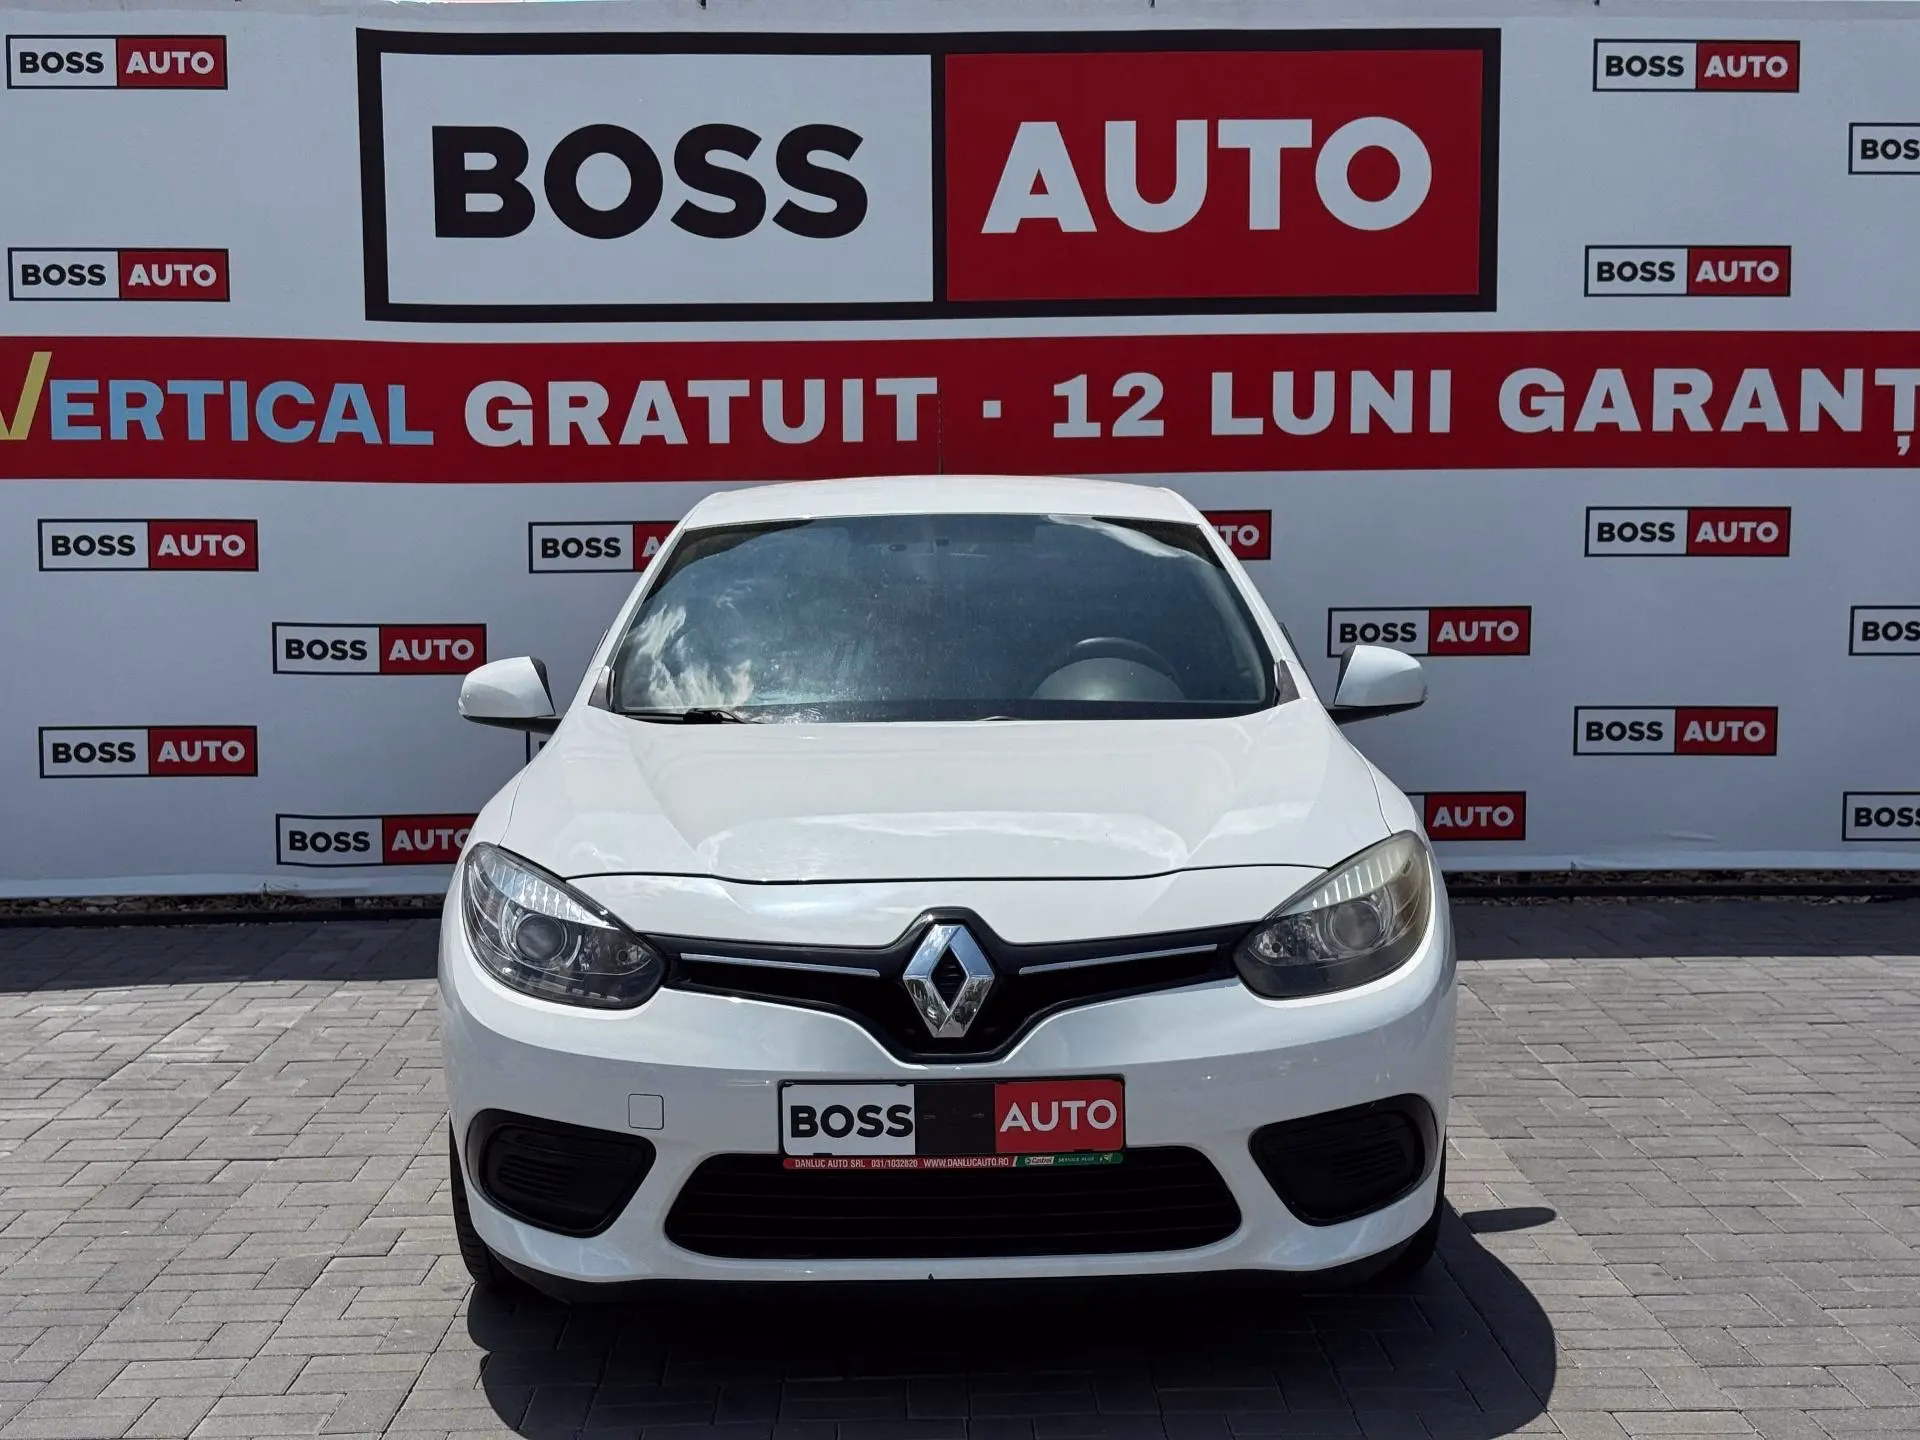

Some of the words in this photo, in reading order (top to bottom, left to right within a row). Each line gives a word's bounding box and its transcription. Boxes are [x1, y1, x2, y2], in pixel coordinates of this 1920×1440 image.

[20, 52, 104, 73] BOSS
[126, 52, 214, 74] AUTO
[1606, 56, 1684, 77] BOSS
[1704, 56, 1788, 77] AUTO
[432, 124, 867, 239] BOSS
[981, 117, 1432, 233] AUTO
[22, 264, 106, 286] BOSS
[129, 264, 216, 286] AUTO
[1597, 261, 1675, 282] BOSS
[1696, 261, 1779, 282] AUTO
[465, 378, 937, 447] GRATUIT
[1054, 373, 1164, 437] 12
[1212, 370, 1451, 435] LUNI
[1216, 524, 1260, 546] TO
[1597, 522, 1675, 542] BOSS
[1696, 522, 1778, 542] AUTO
[52, 535, 135, 556] BOSS
[158, 535, 245, 556] AUTO
[542, 537, 621, 558] BOSS
[1340, 623, 1417, 643] BOSS
[1437, 621, 1519, 642] AUTO
[286, 639, 367, 660] BOSS
[389, 639, 474, 660] AUTO
[1586, 721, 1663, 741] BOSS
[1683, 721, 1765, 742] AUTO
[53, 742, 136, 763] BOSS
[158, 741, 245, 762] AUTO
[1433, 806, 1514, 827] AUTO
[289, 831, 370, 852] BOSS
[791, 1105, 913, 1138] BOSS
[1000, 1100, 1116, 1132] AUTO
[795, 1159, 826, 1168] DANLUC
[828, 1159, 848, 1168] AUTO
[850, 1159, 866, 1168] SRL
[923, 1157, 1009, 1168] WWW.DANLUCAUTO.RO
